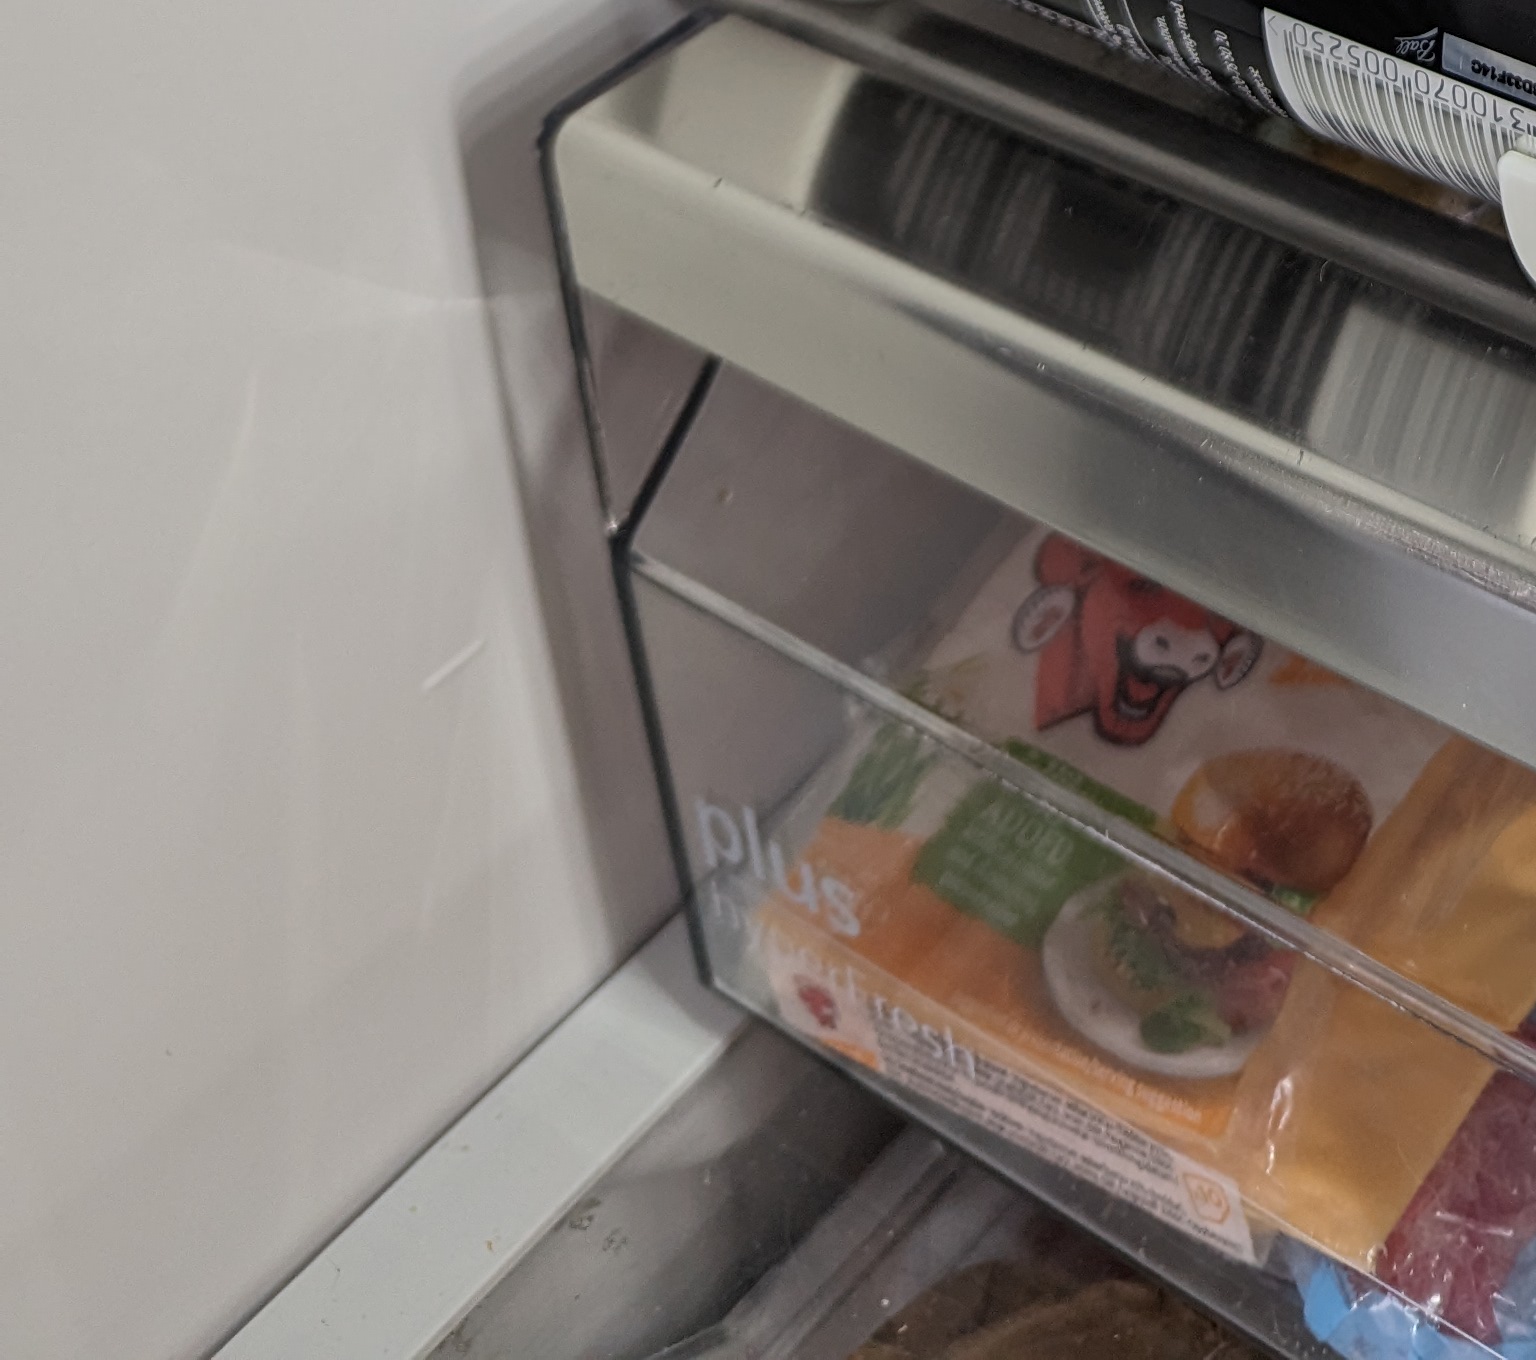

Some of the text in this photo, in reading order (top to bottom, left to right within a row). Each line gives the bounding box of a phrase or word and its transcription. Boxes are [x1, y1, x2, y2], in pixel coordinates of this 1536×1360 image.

[1292, 22, 1399, 82] 005250
[1414, 69, 1525, 132] 310070
[694, 800, 861, 938] plus
